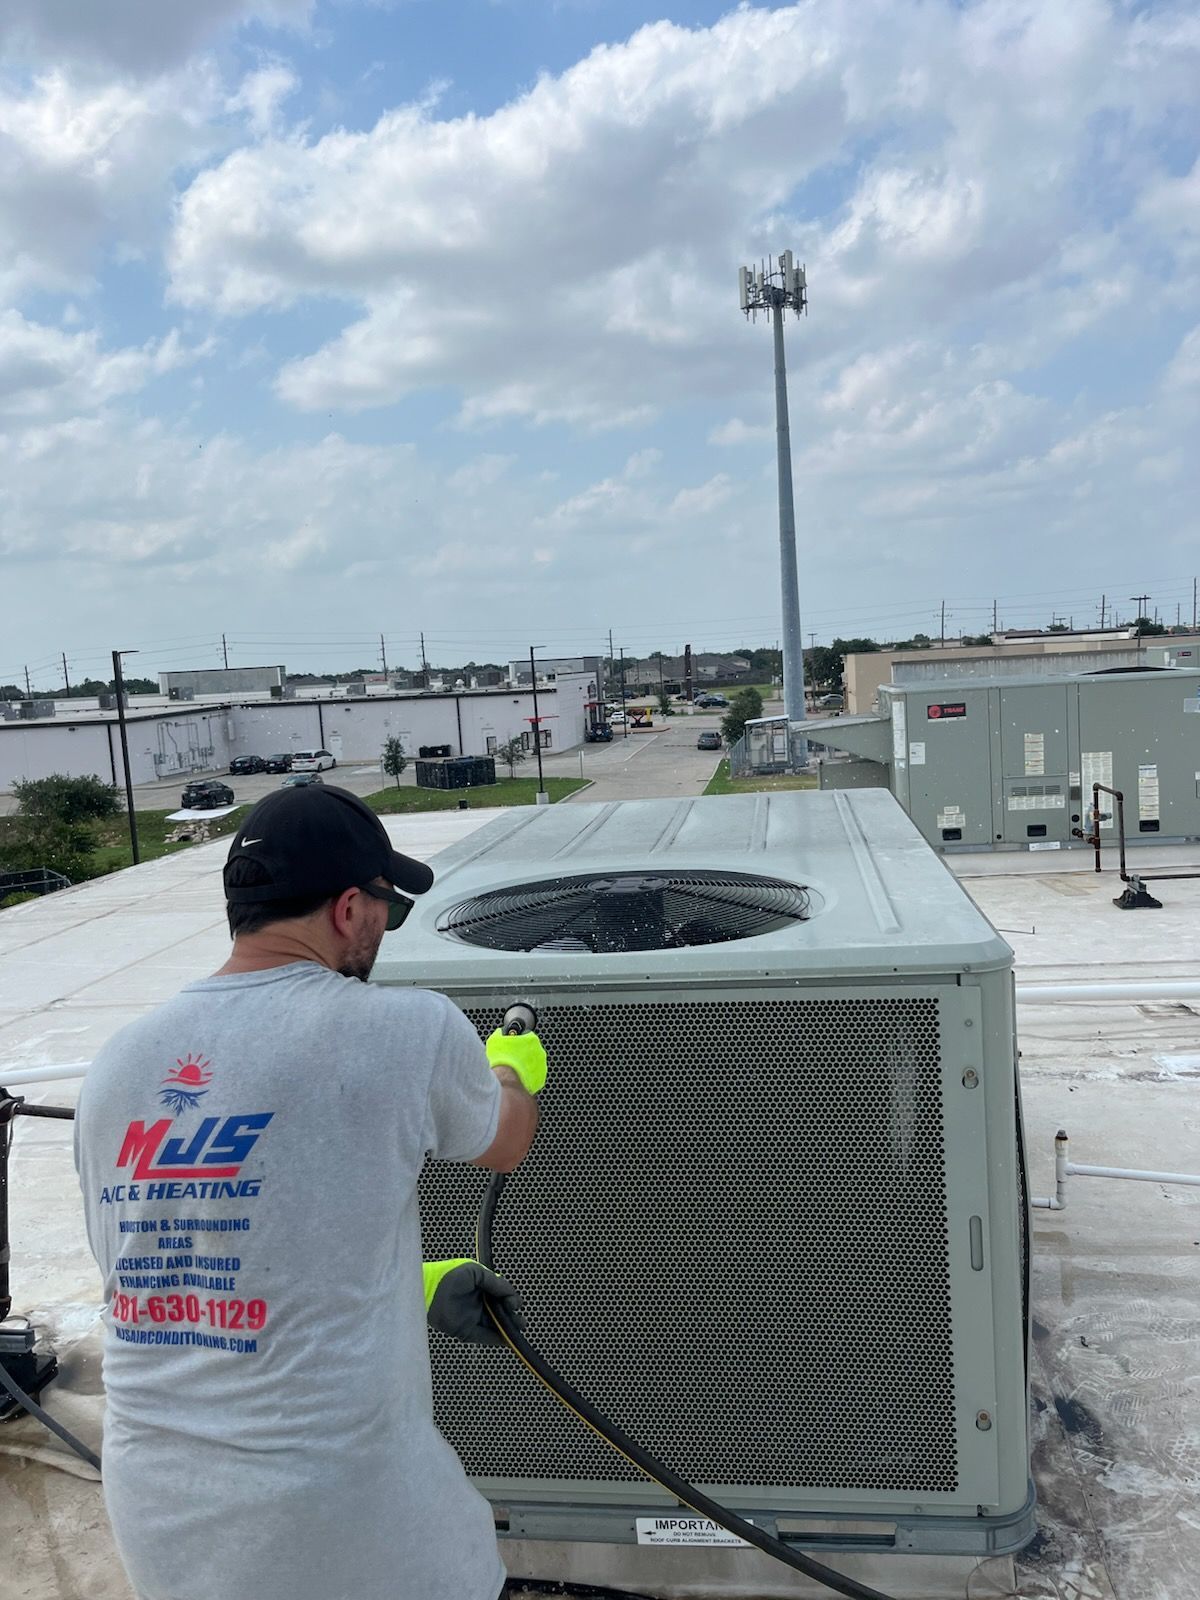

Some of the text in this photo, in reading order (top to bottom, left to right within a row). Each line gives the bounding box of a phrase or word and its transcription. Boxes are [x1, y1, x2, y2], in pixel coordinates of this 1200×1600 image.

[116, 1112, 276, 1180] MJS
[100, 1179, 262, 1205] A/C & HEATING
[160, 1219, 171, 1232] &
[173, 1218, 250, 1232] SURROUNDING
[158, 1236, 193, 1249] AREAS
[166, 1255, 192, 1269] AND
[195, 1255, 241, 1271] INSURED
[119, 1273, 236, 1291] FINANCING AVAILABLE
